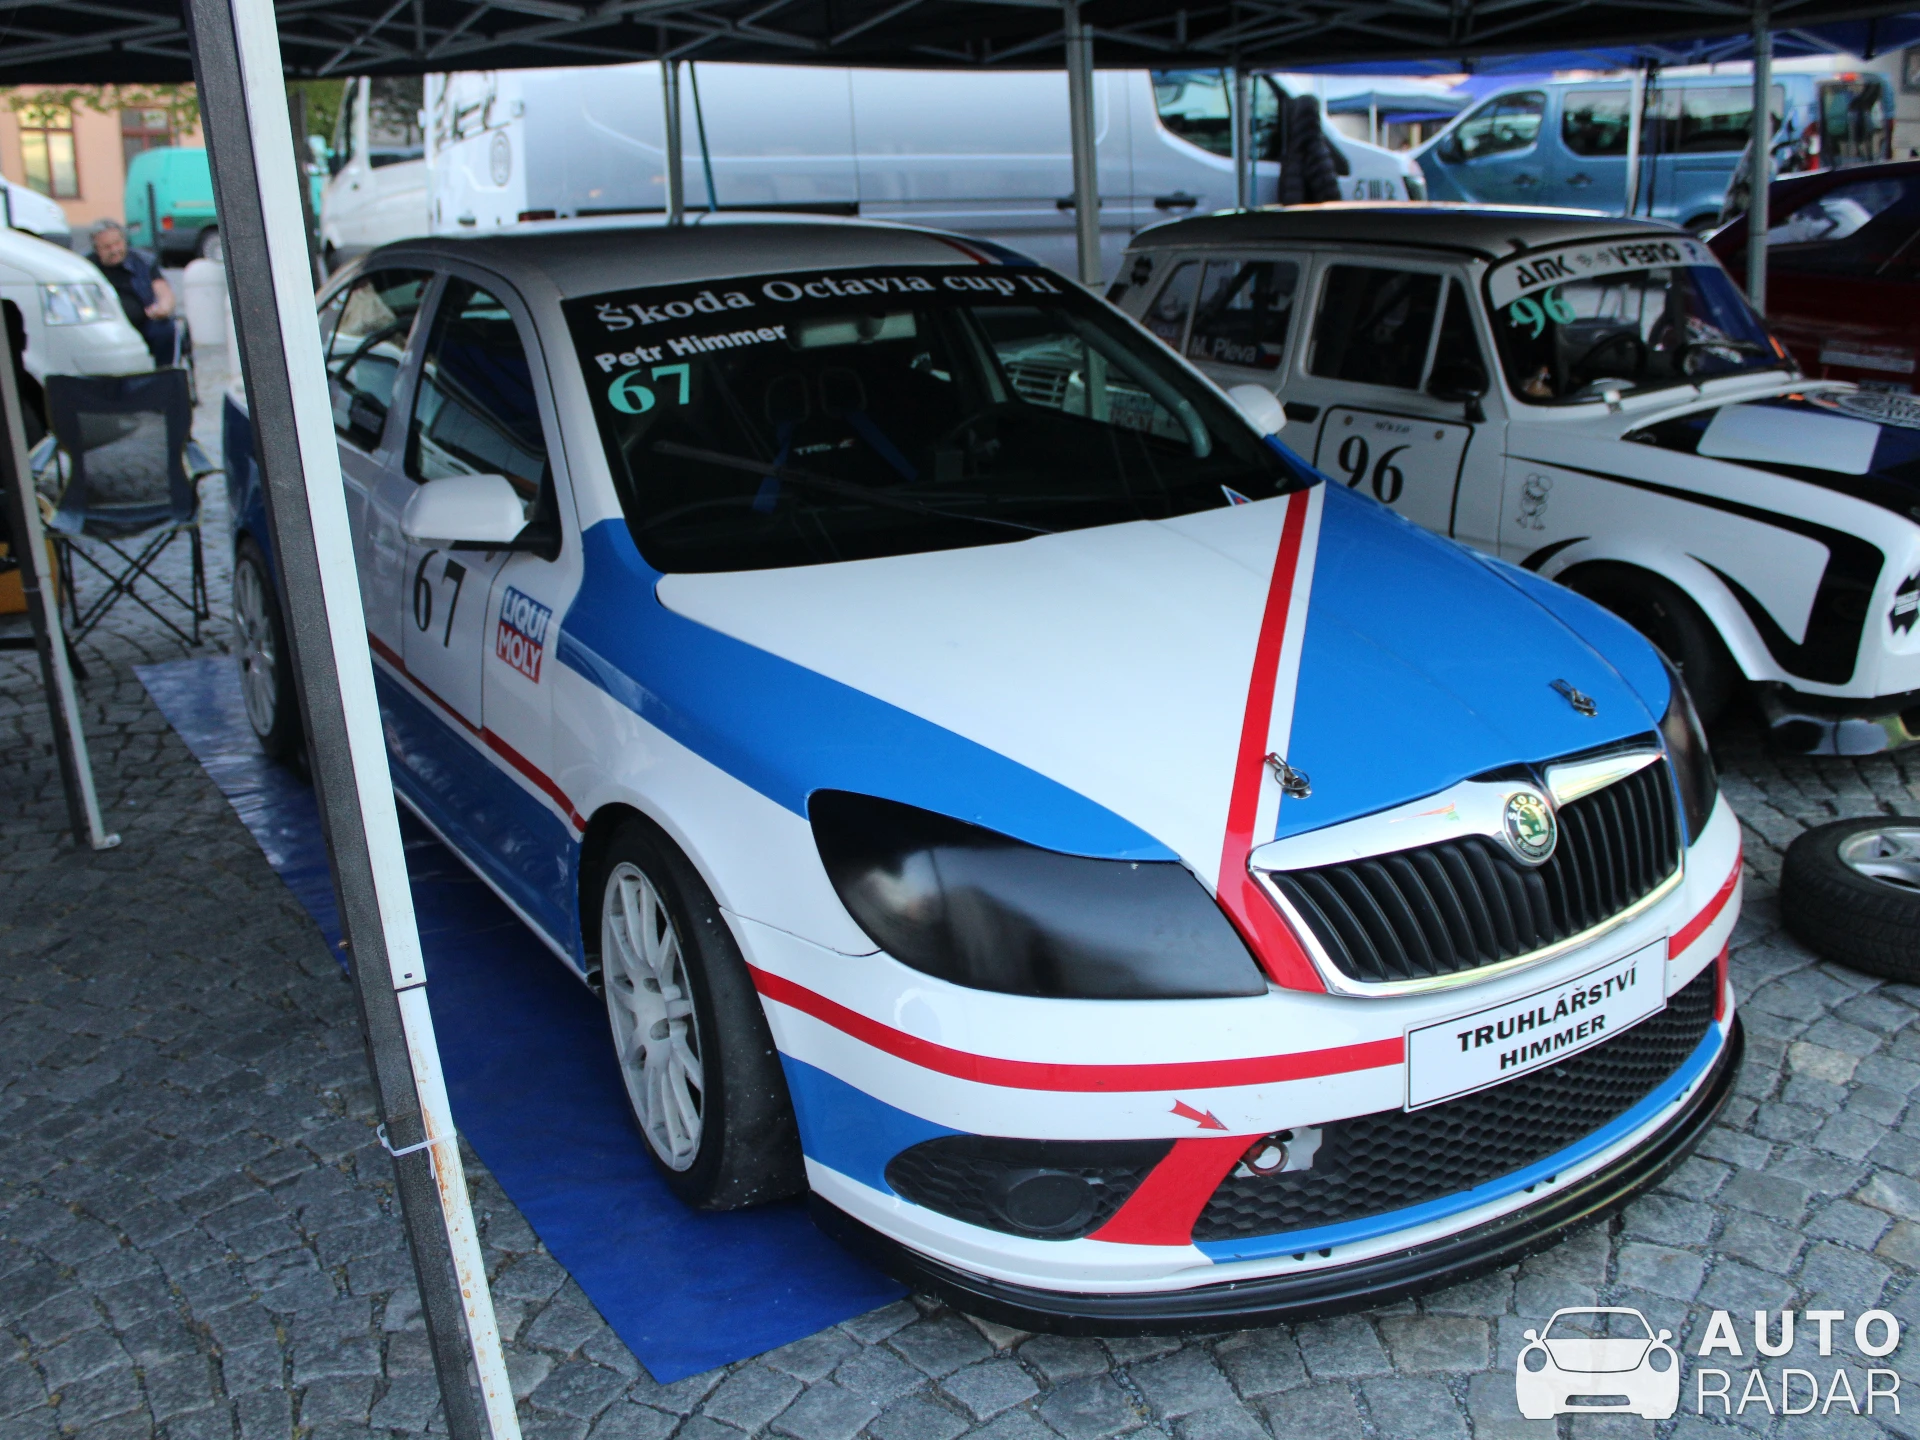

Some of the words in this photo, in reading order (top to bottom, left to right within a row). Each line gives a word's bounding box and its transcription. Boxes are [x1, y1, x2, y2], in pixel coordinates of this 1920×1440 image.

[595, 290, 756, 333] Škoda
[761, 276, 937, 303] Octavia
[942, 275, 1016, 297] cup
[1016, 274, 1064, 295] II
[1509, 285, 1577, 340] 96
[595, 345, 663, 373] Petr
[667, 324, 788, 357] Himmer
[607, 362, 691, 415] 67
[1338, 435, 1412, 504] 96
[412, 549, 467, 648] 67
[502, 589, 549, 643] LIQUI
[498, 624, 542, 678] MOLY
[1457, 960, 1637, 1053] TRUHLÁŘSTVÍ
[1500, 1014, 1606, 1070] HIMMER
